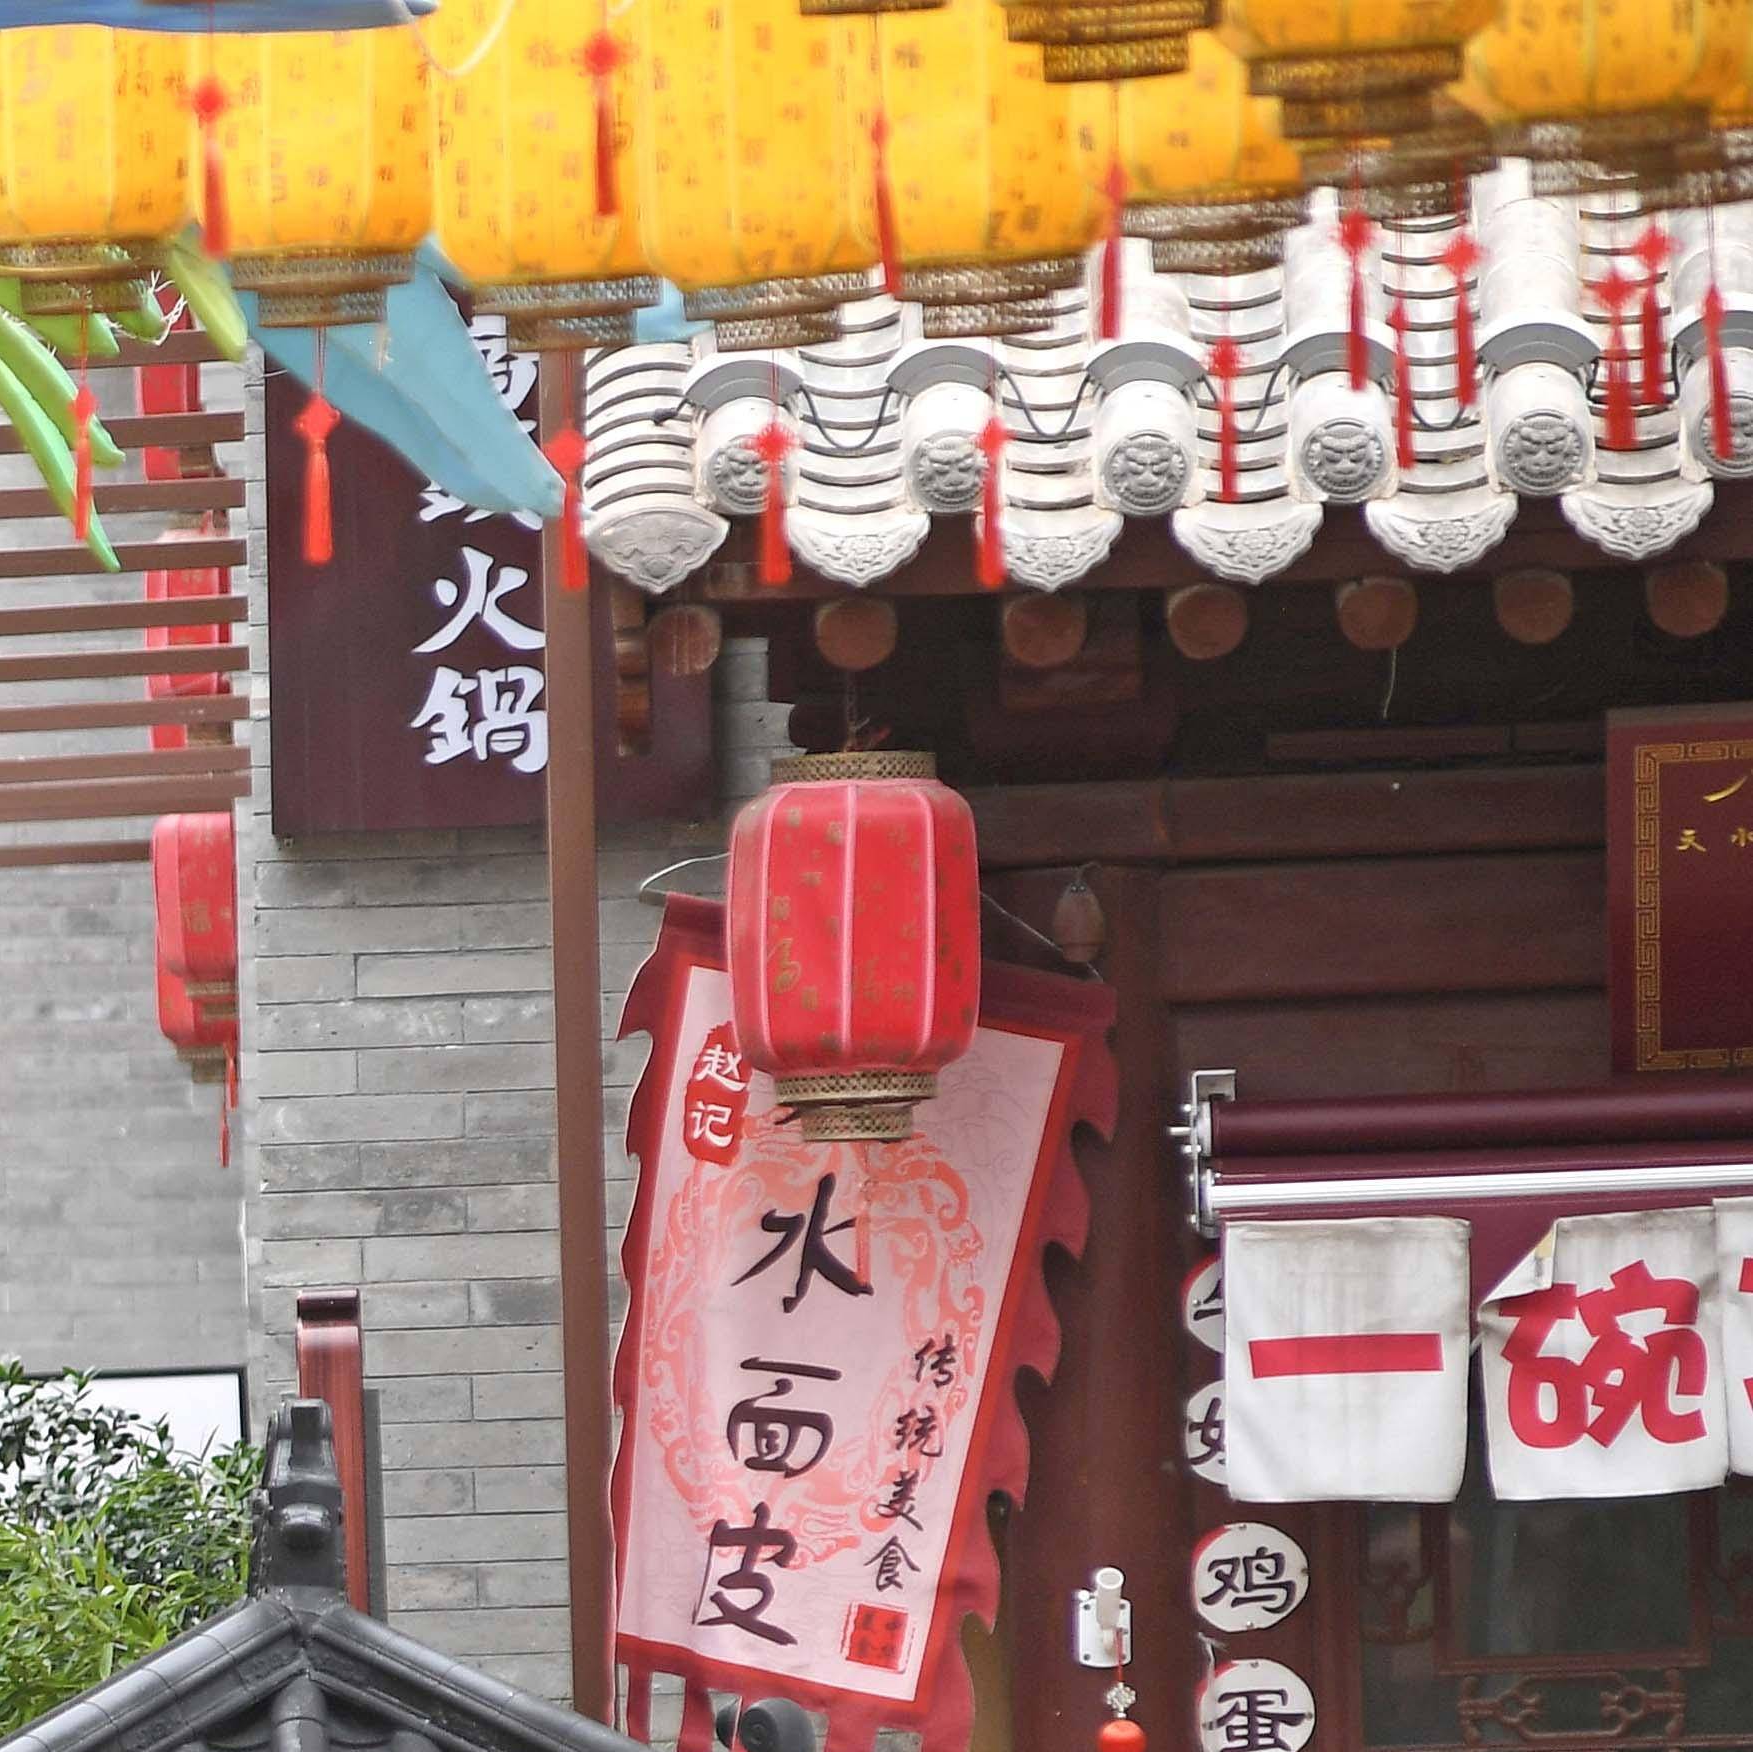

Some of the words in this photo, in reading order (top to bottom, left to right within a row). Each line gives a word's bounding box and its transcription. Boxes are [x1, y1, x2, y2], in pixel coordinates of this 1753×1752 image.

[411, 315, 548, 773] 火鍋
[692, 1044, 746, 1147] 赵记
[694, 1105, 876, 1648] 水面皮
[865, 1339, 957, 1593] 传统美食
[1248, 1258, 1753, 1450] 一碗
